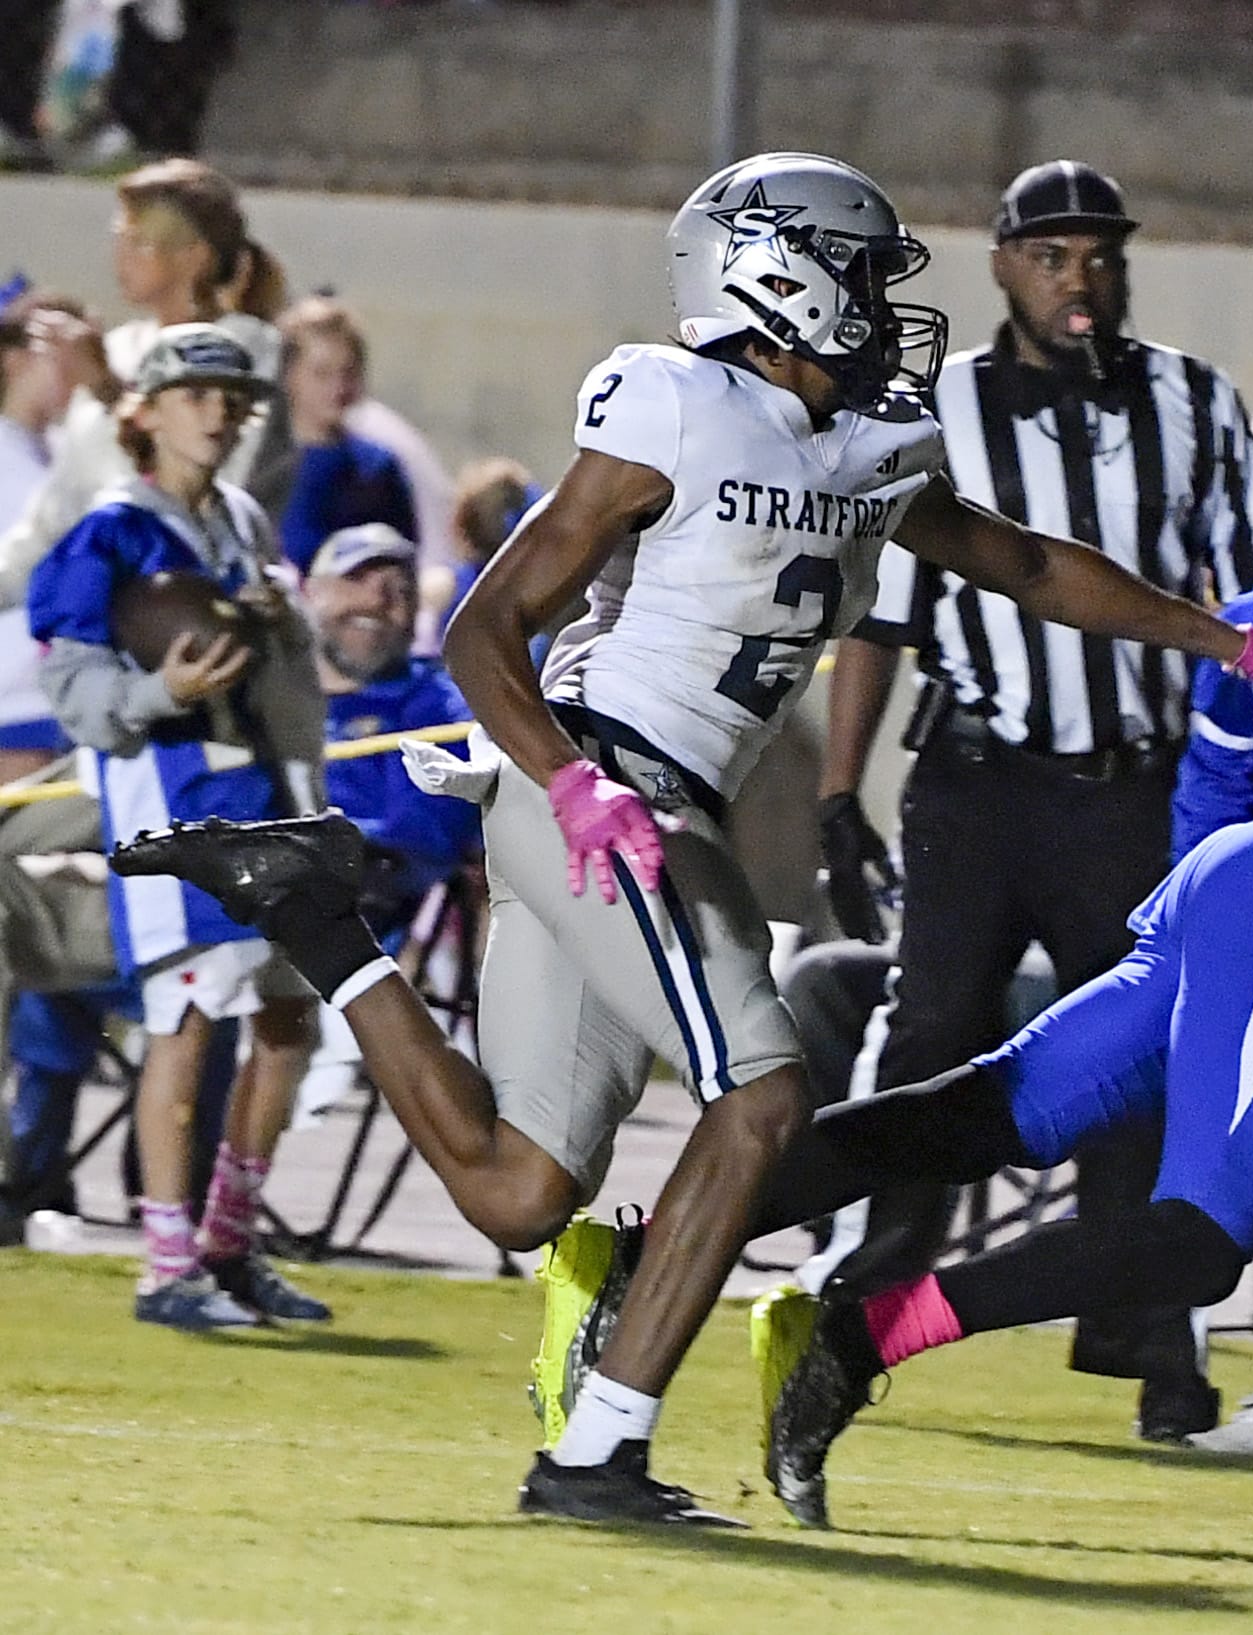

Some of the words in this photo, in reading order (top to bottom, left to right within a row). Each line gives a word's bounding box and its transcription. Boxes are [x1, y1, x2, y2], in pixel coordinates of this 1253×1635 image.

[733, 208, 777, 241] S
[585, 373, 622, 427] 2
[713, 554, 843, 721] 2
